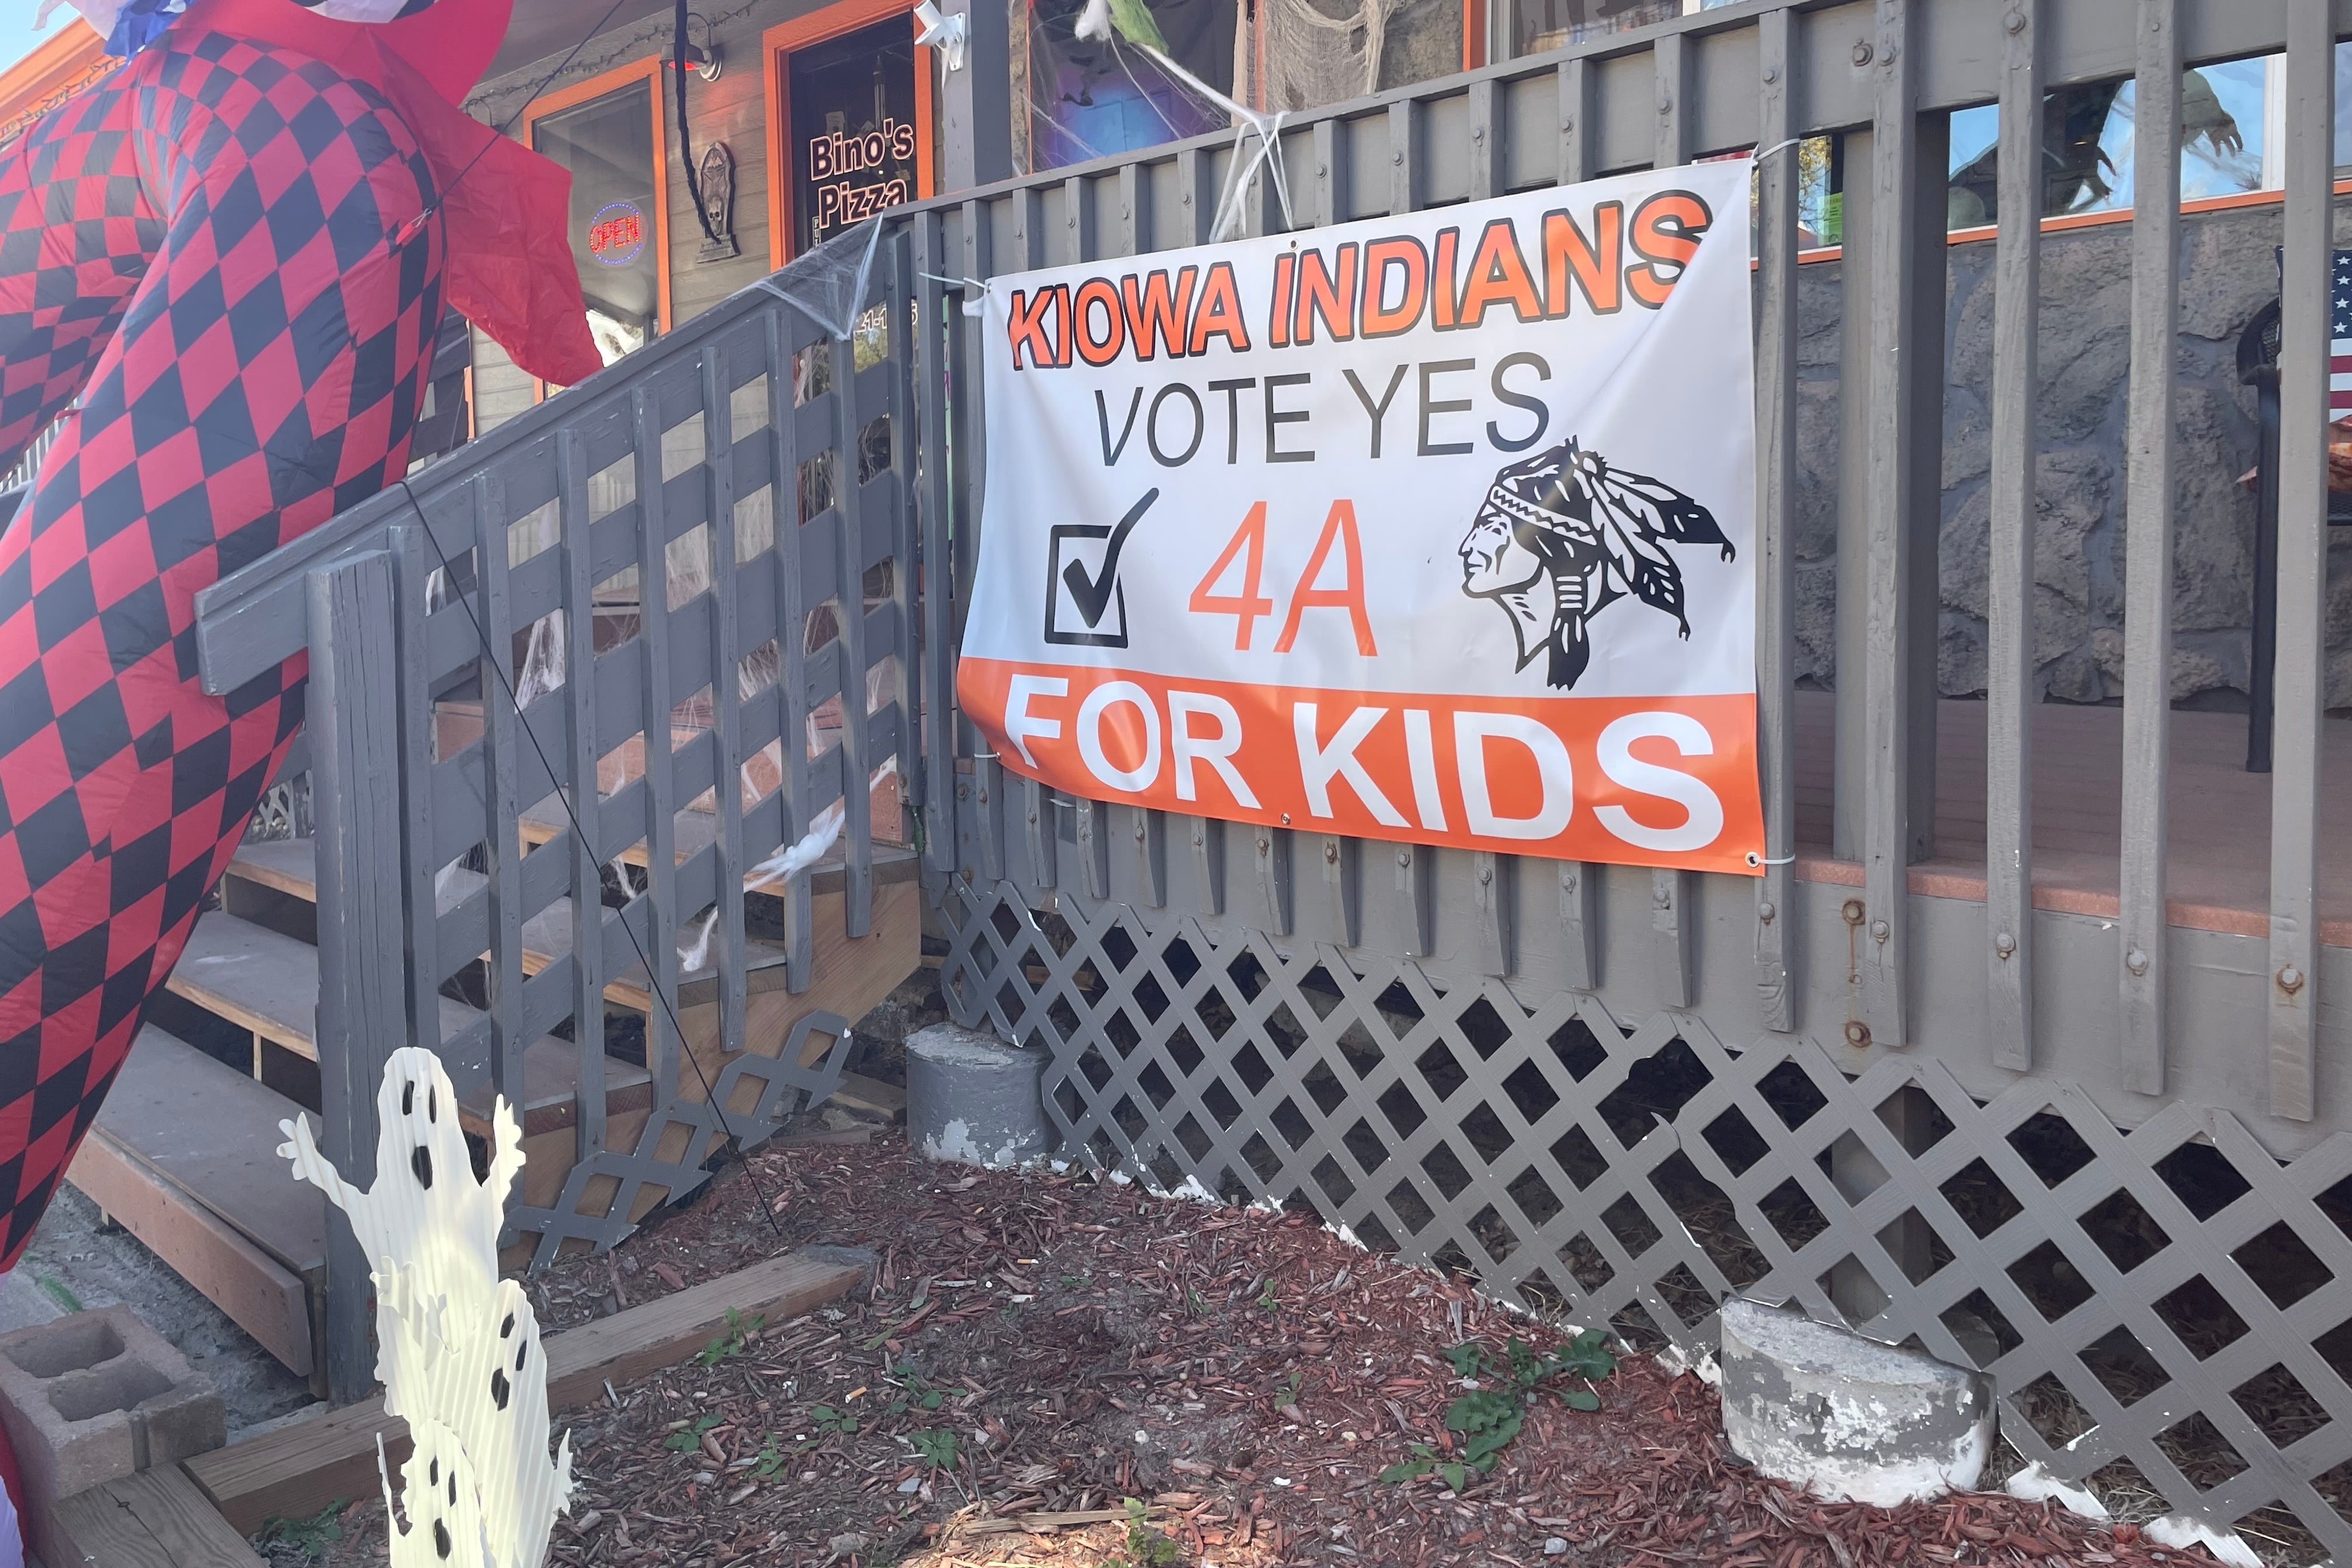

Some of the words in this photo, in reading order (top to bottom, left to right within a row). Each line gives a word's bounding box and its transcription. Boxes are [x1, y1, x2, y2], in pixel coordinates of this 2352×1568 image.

[810, 117, 914, 181] Bino's
[818, 178, 907, 229] Pizza
[589, 215, 639, 253] OPEN
[1007, 261, 1251, 370] KIOWA
[1269, 190, 1714, 348] INDIANS
[1094, 373, 1316, 468] VOTE
[1341, 351, 1552, 459] YES
[1188, 498, 1378, 657] 4A
[1003, 674, 1262, 810] FOR
[1293, 702, 1724, 852] KIDS
